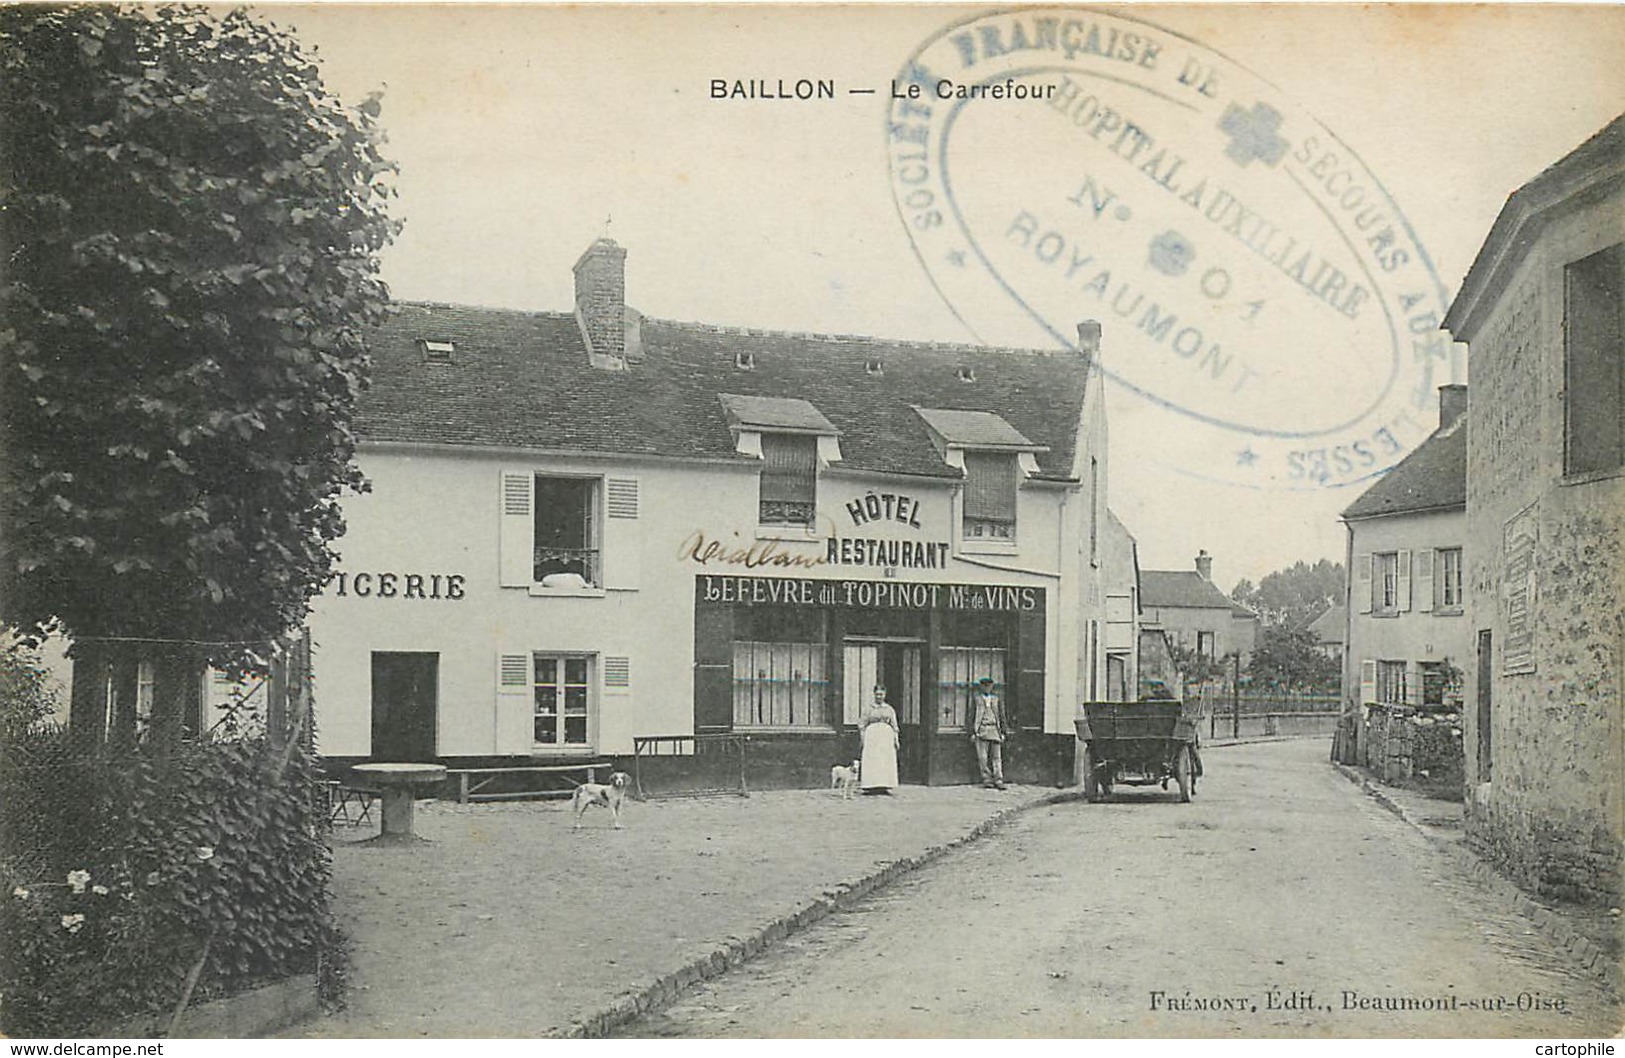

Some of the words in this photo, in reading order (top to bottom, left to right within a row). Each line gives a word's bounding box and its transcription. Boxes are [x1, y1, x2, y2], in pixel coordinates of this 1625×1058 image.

[846, 490, 921, 530] HÔTEL
[827, 537, 949, 570] RESTAURANT
[704, 576, 814, 604] LEFEVRE
[842, 581, 941, 610] TOPINOT
[971, 592, 984, 610] de
[985, 587, 1037, 611] VINS
